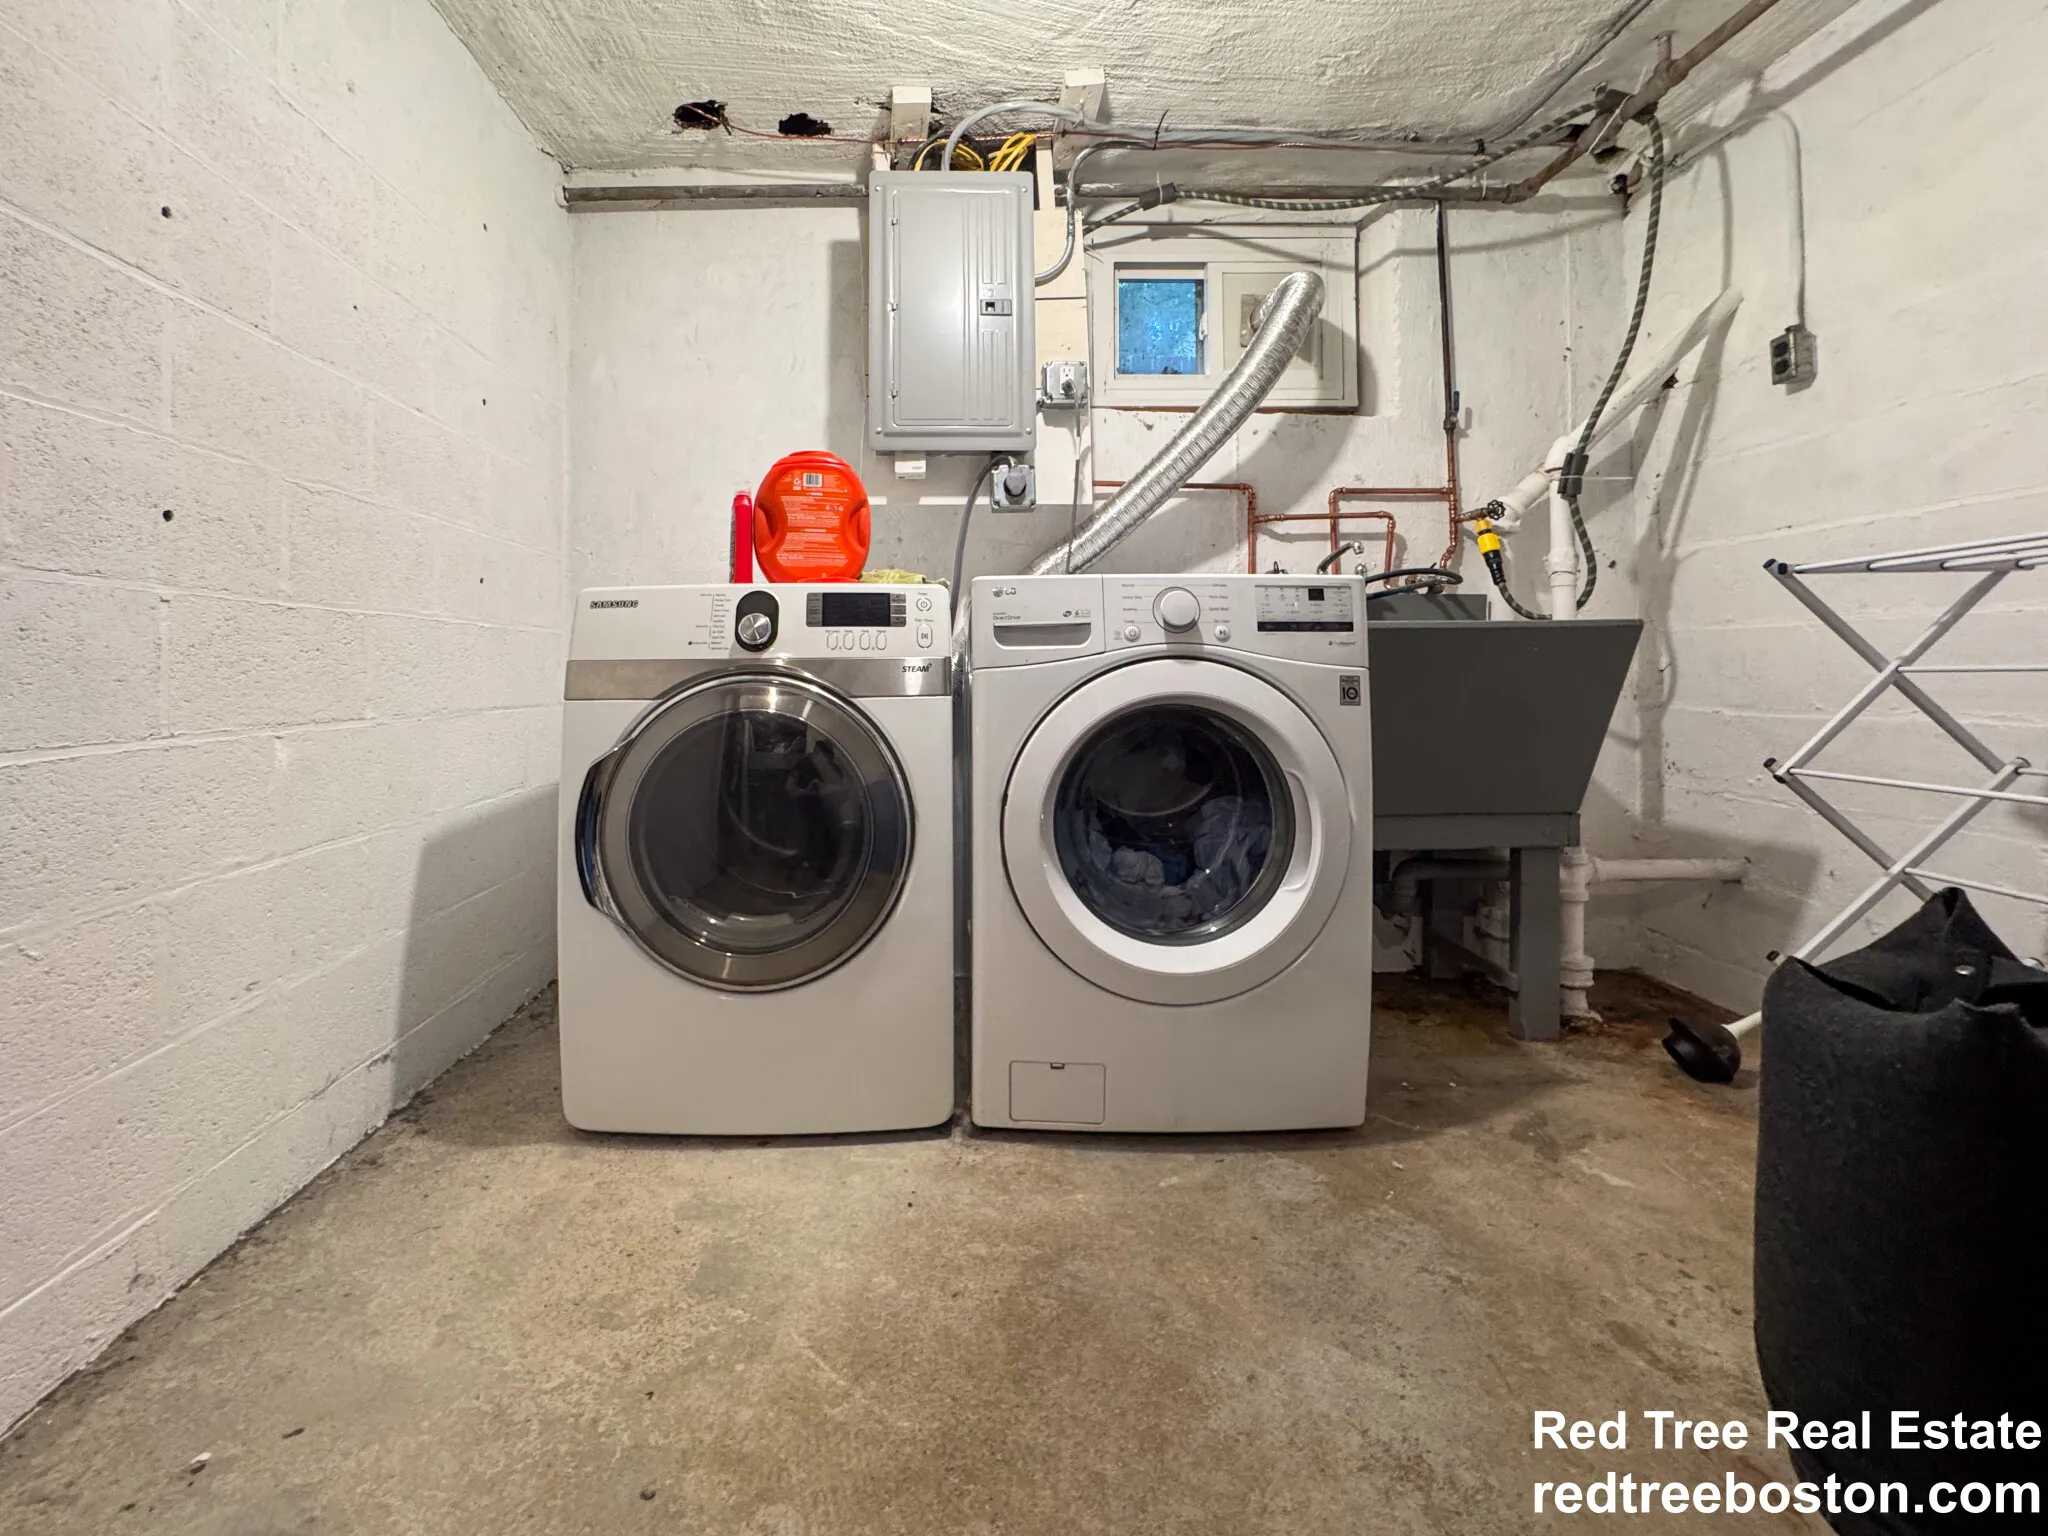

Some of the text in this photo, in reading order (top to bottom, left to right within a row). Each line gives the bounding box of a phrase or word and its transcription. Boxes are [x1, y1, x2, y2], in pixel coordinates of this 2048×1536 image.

[589, 600, 639, 609] SAMSUNG
[901, 665, 930, 673] STEAM
[1342, 687, 1358, 700] 10
